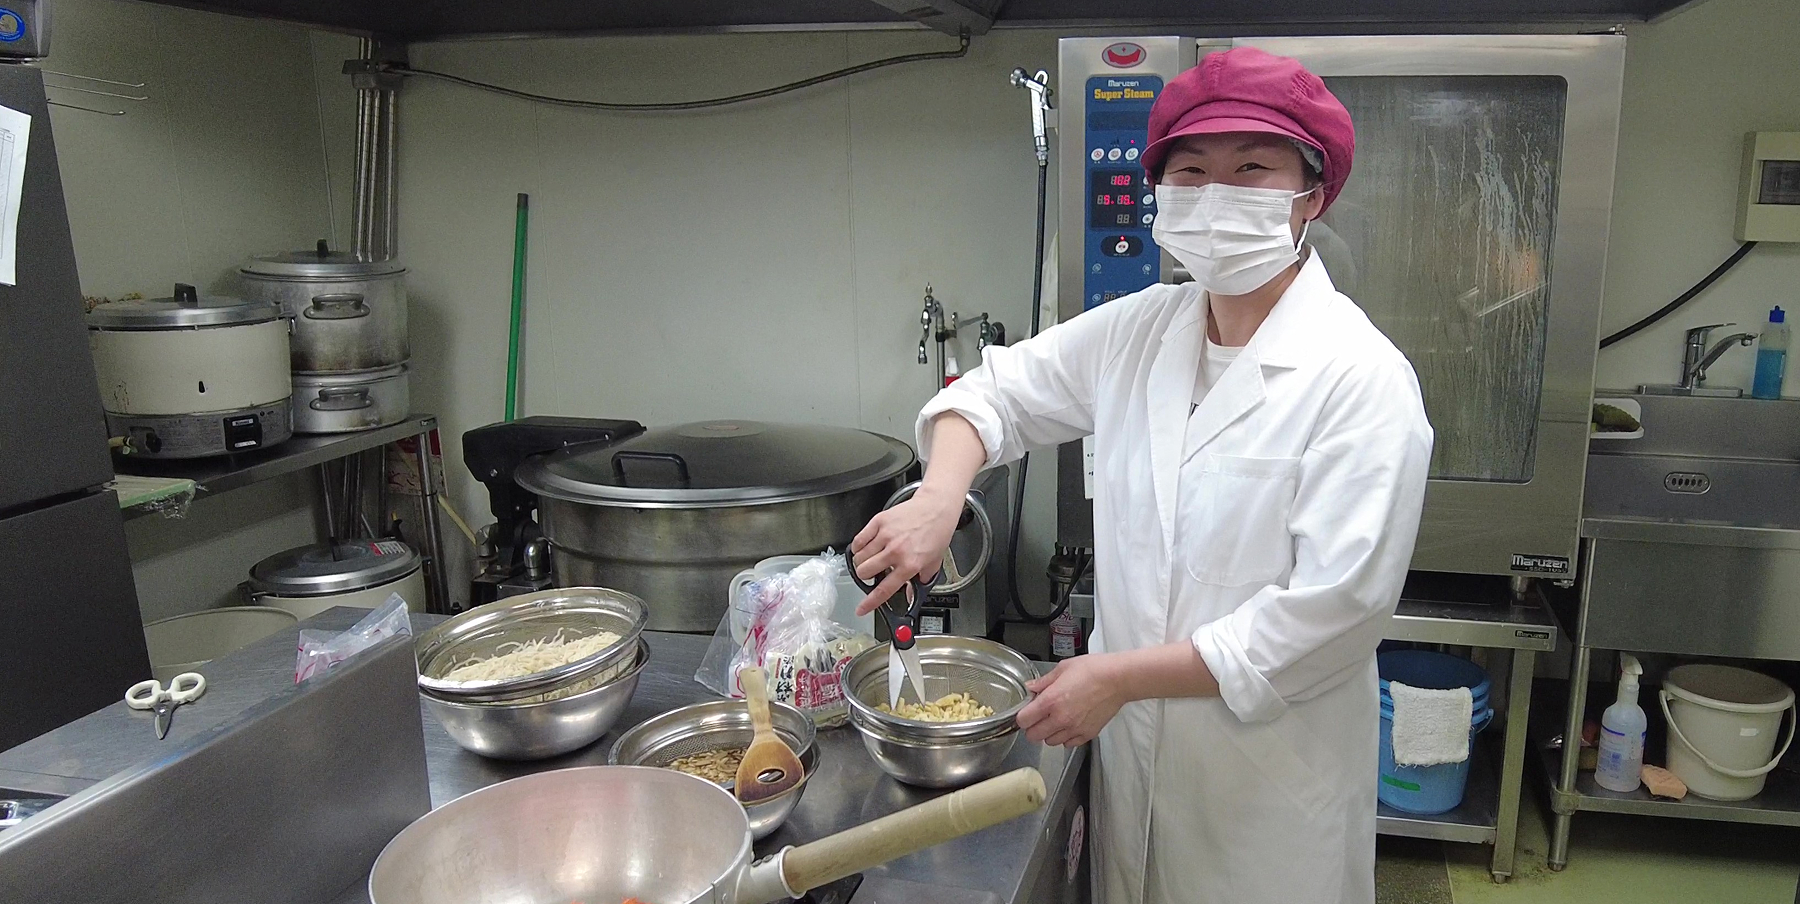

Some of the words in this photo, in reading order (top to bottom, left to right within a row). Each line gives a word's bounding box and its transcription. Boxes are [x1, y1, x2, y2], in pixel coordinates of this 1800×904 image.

[1107, 79, 1139, 87] Maruzen
[1094, 88, 1123, 101] Super
[1124, 88, 1154, 98] Steam
[1512, 555, 1568, 568] Maruzen
[1516, 630, 1548, 639] Maruzen
